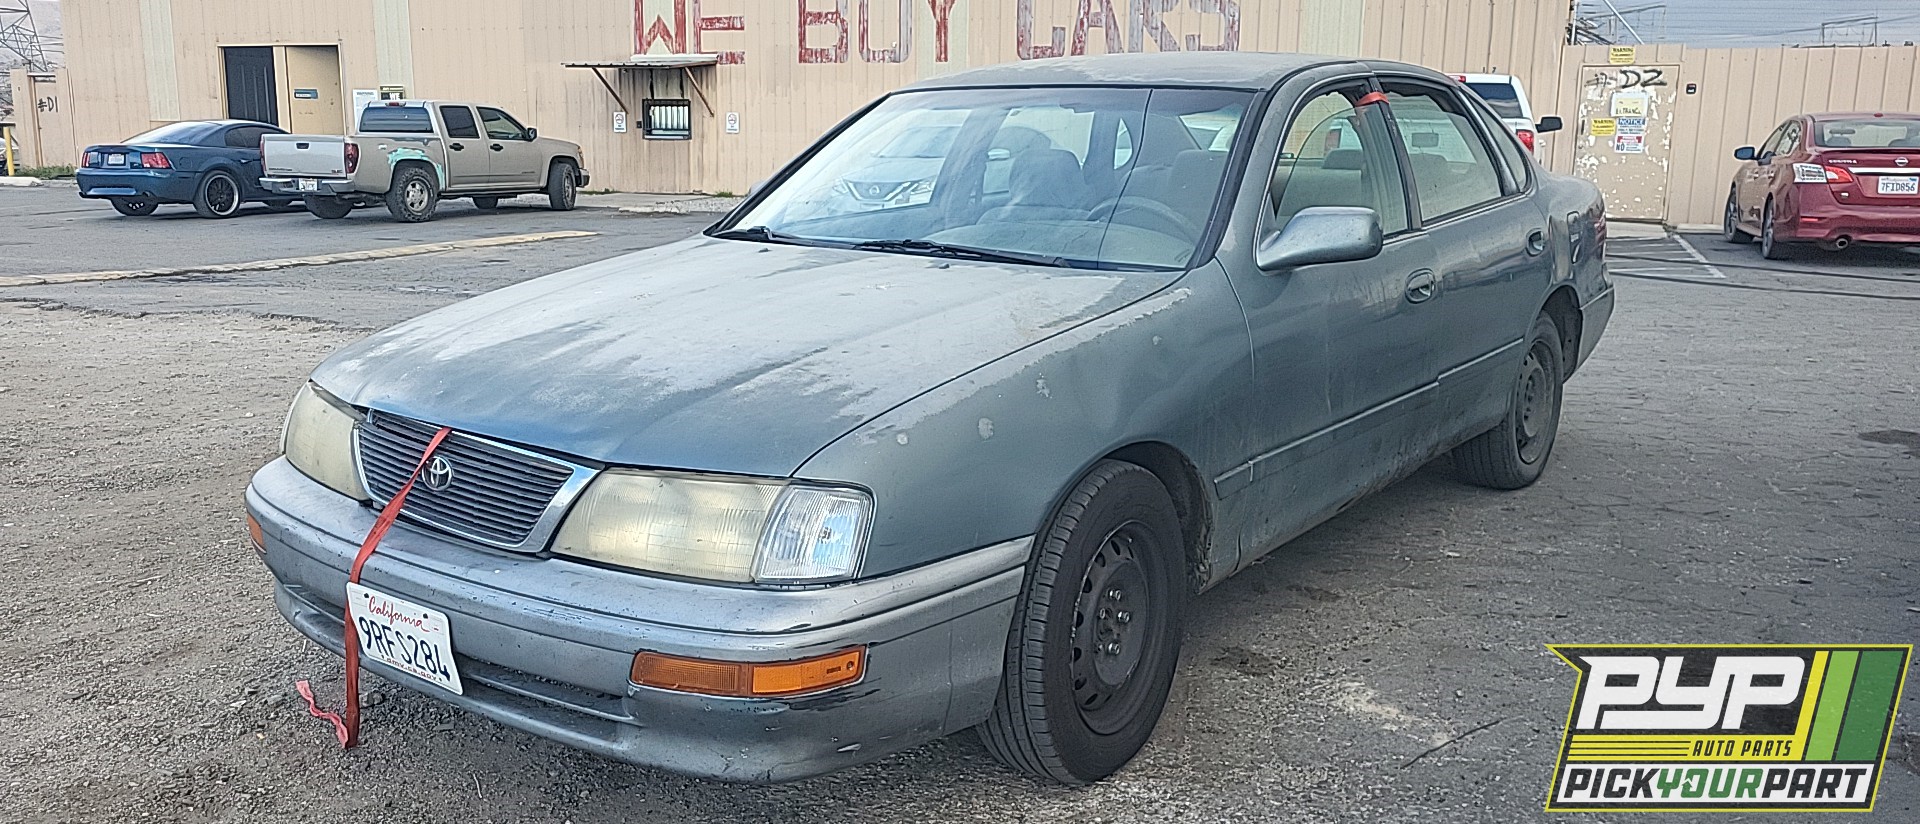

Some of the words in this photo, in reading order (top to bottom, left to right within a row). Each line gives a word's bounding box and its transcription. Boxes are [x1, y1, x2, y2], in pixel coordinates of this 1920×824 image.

[634, 0, 746, 65] WE
[798, 0, 955, 63] BUY
[1016, 0, 1240, 60] CARS
[369, 596, 431, 632] California
[359, 616, 451, 681] 9RFS284
